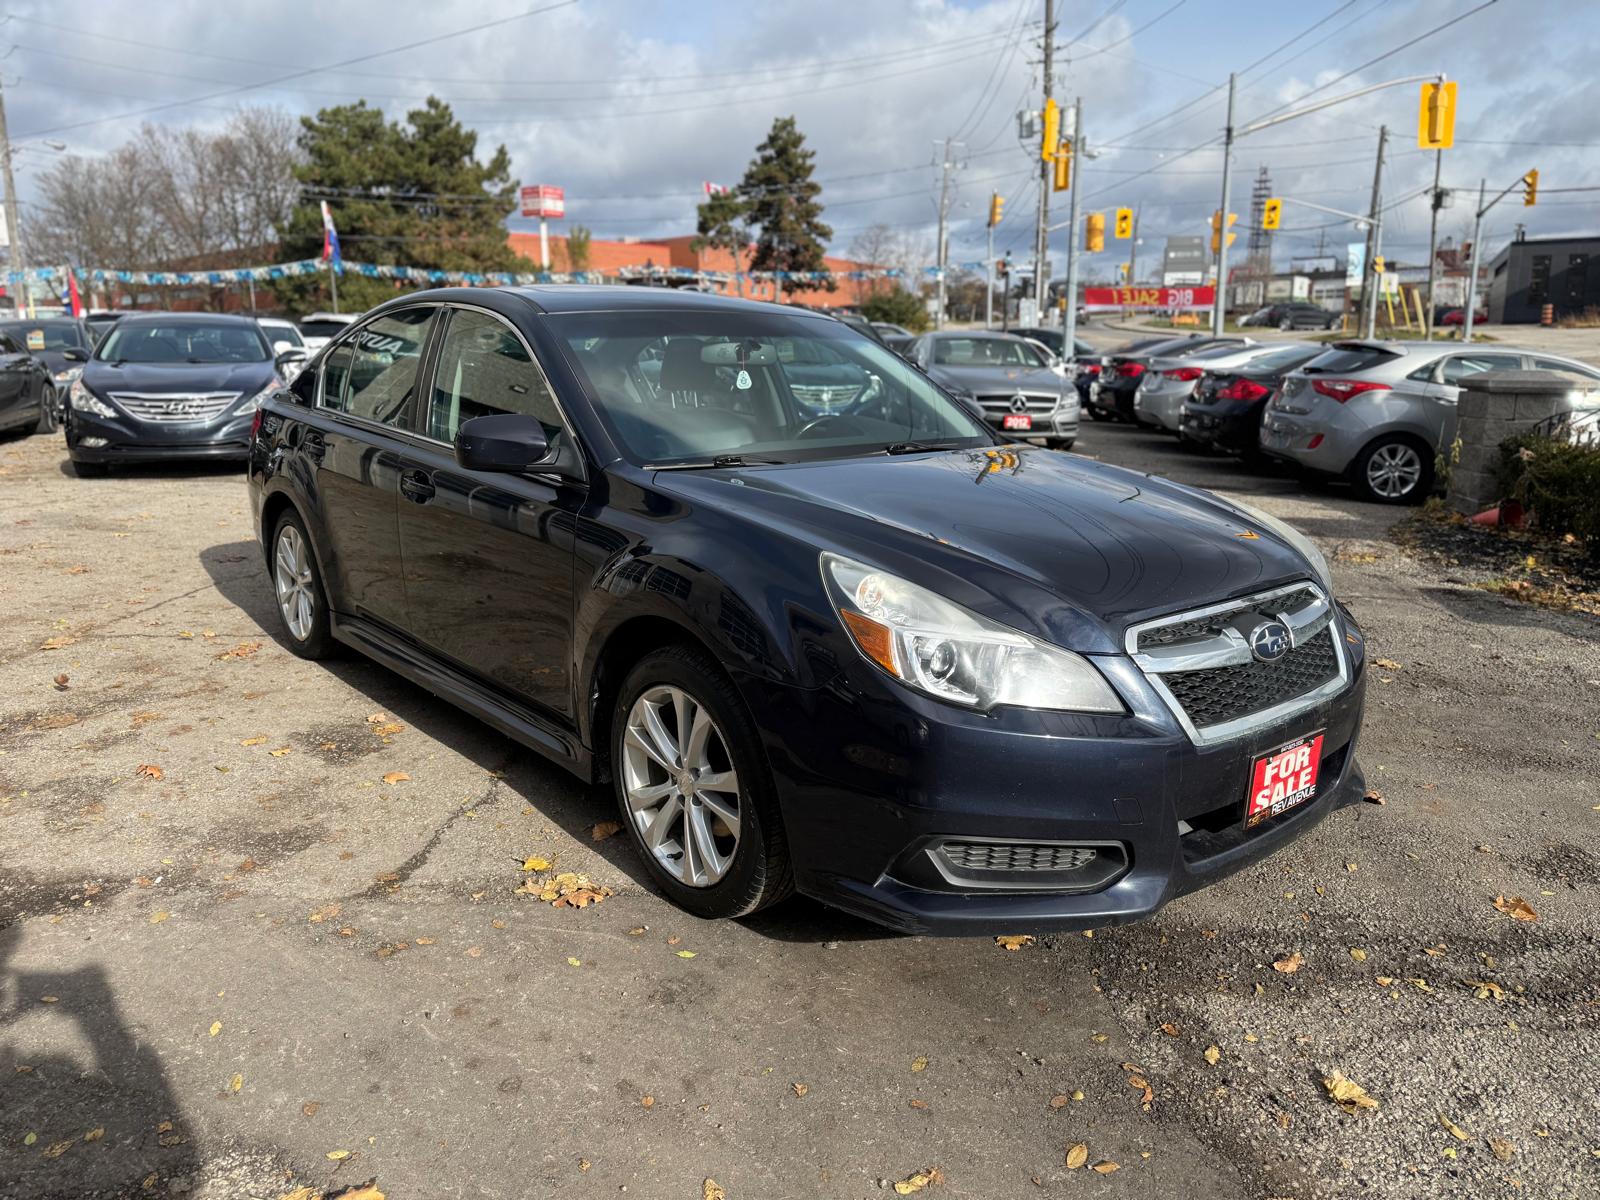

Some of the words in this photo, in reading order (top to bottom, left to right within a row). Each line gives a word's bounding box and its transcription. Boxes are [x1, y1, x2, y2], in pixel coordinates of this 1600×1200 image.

[1007, 417, 1029, 427] 2012
[1264, 746, 1311, 786] FOR
[1254, 766, 1312, 812] SALE
[1271, 799, 1290, 815] REV
[1287, 784, 1317, 808] AVENUE
